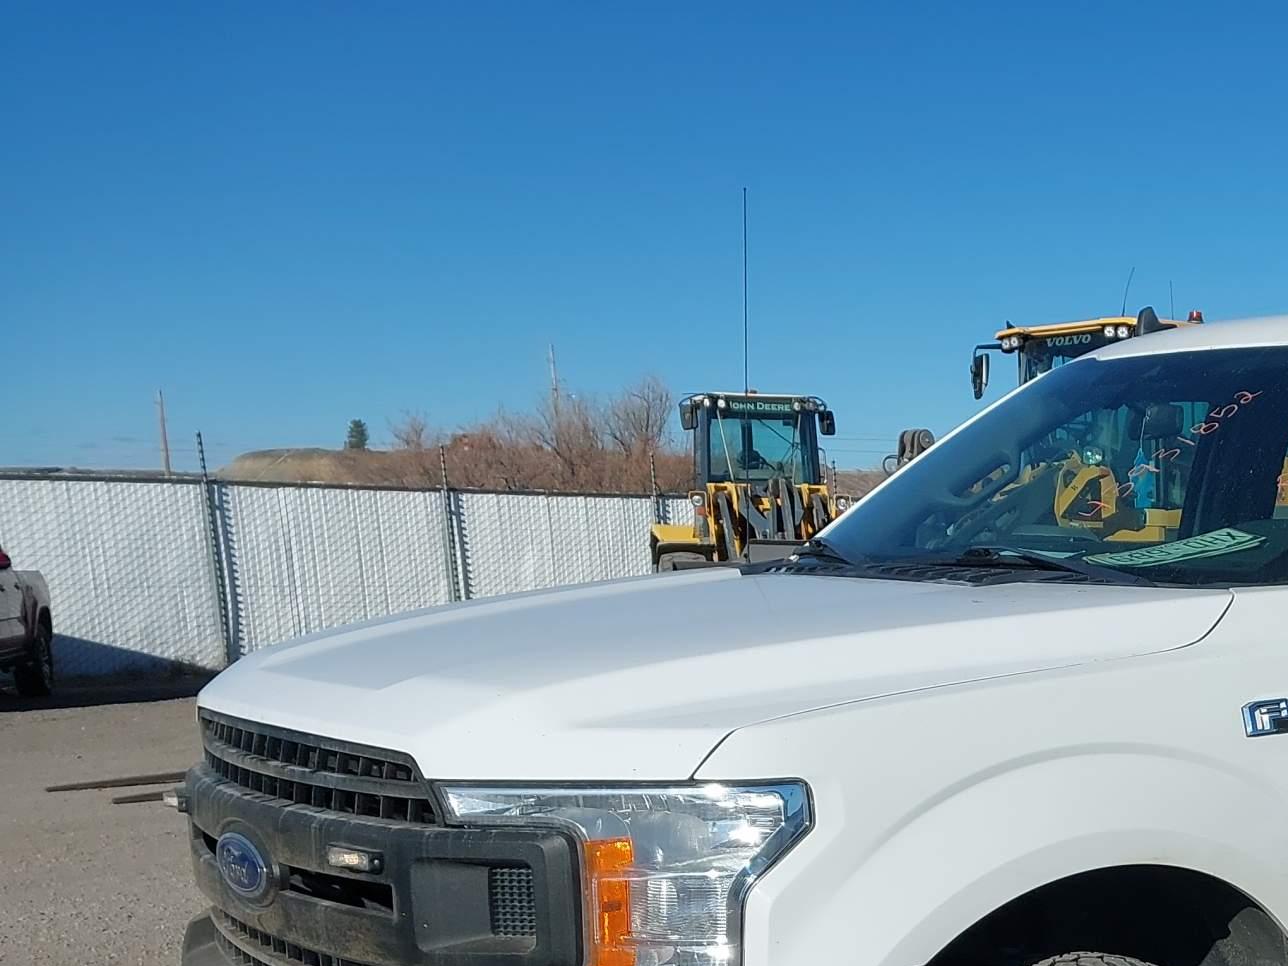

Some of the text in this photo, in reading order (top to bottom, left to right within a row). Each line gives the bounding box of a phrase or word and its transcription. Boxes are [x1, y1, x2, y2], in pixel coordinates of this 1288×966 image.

[1046, 334, 1091, 347] VOLVO
[729, 401, 791, 412] JOHN DEERE
